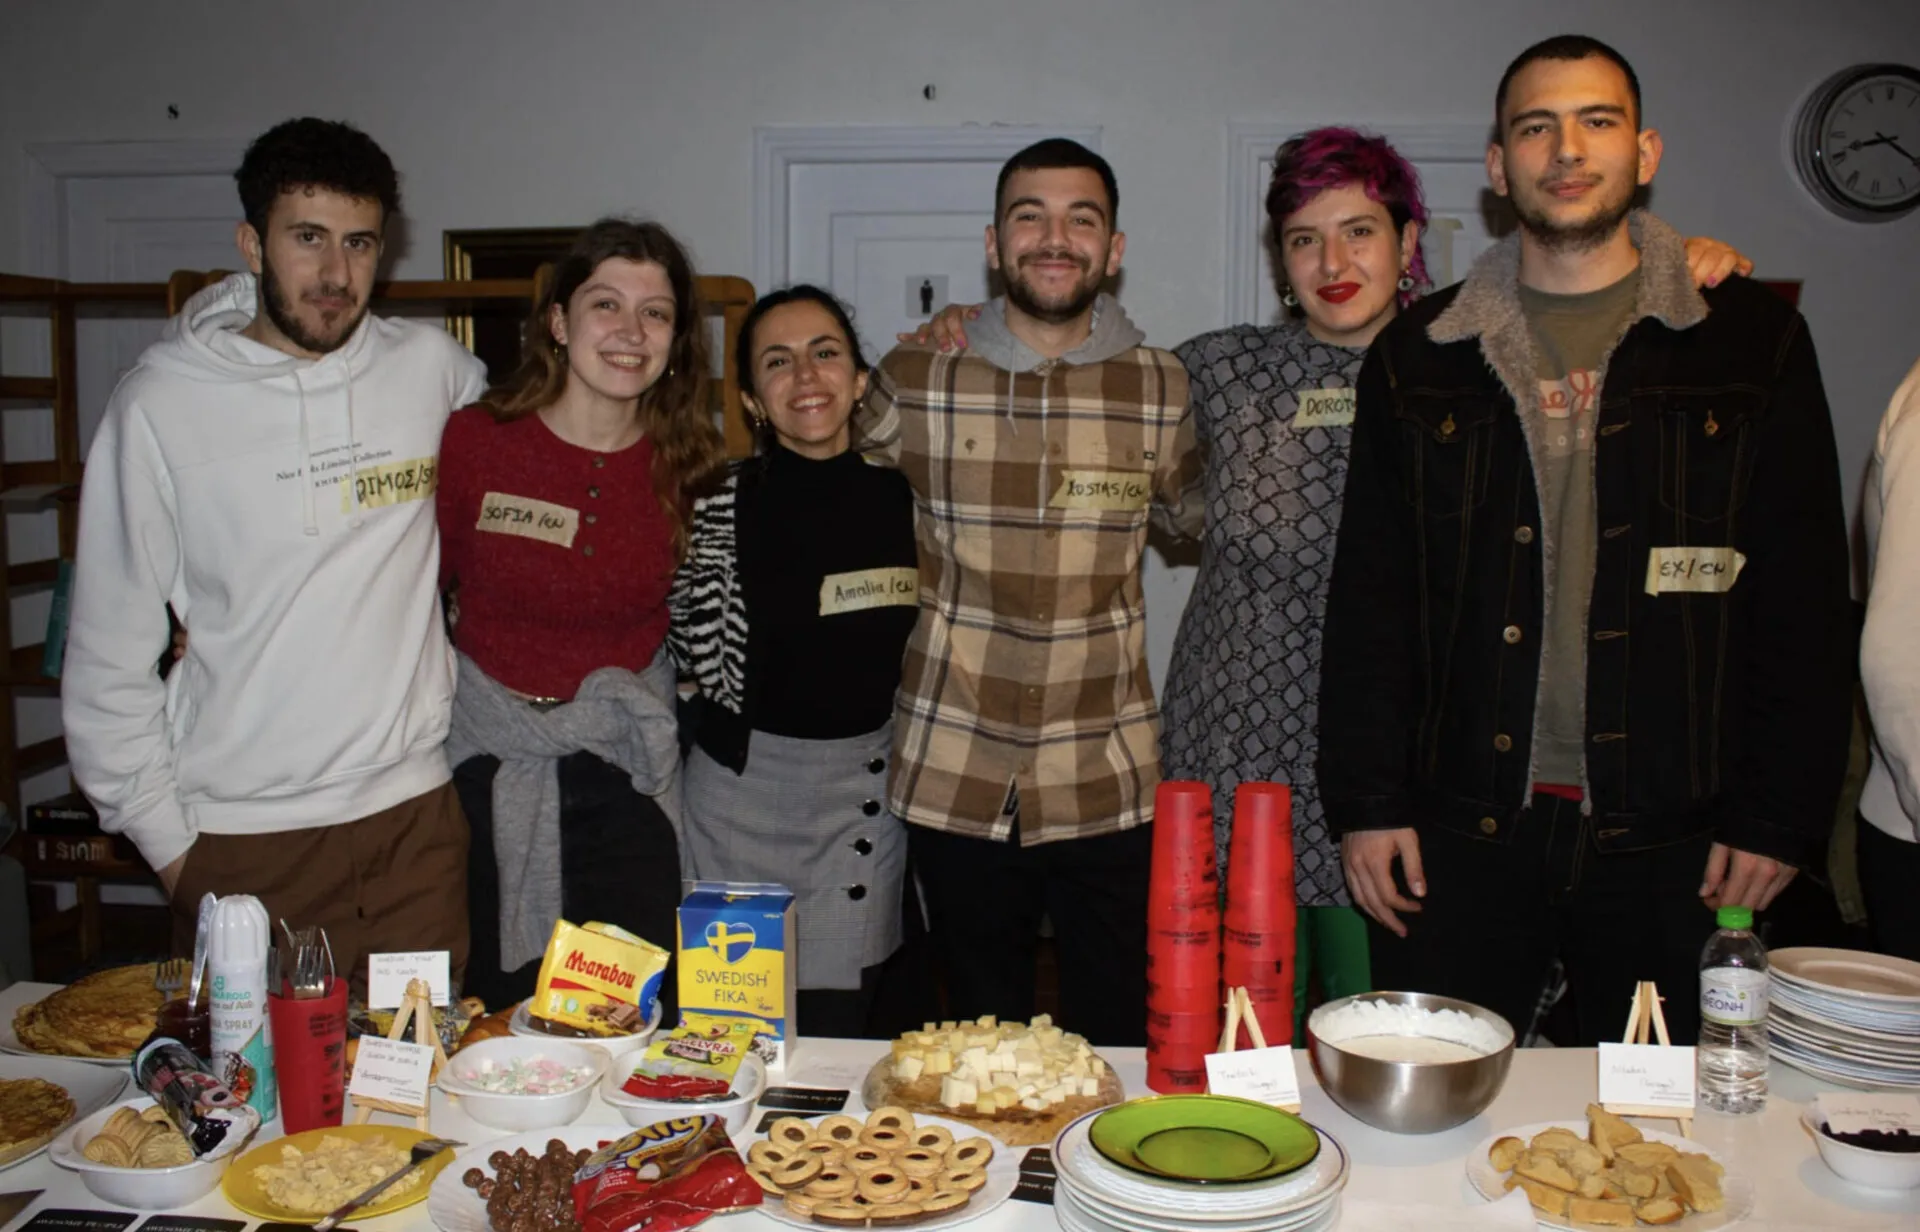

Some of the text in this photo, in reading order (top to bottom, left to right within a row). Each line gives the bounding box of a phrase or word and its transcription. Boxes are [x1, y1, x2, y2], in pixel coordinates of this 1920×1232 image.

[564, 949, 636, 990] Marabou
[695, 968, 768, 987] SWEDISH
[714, 988, 748, 1004] FIKA
